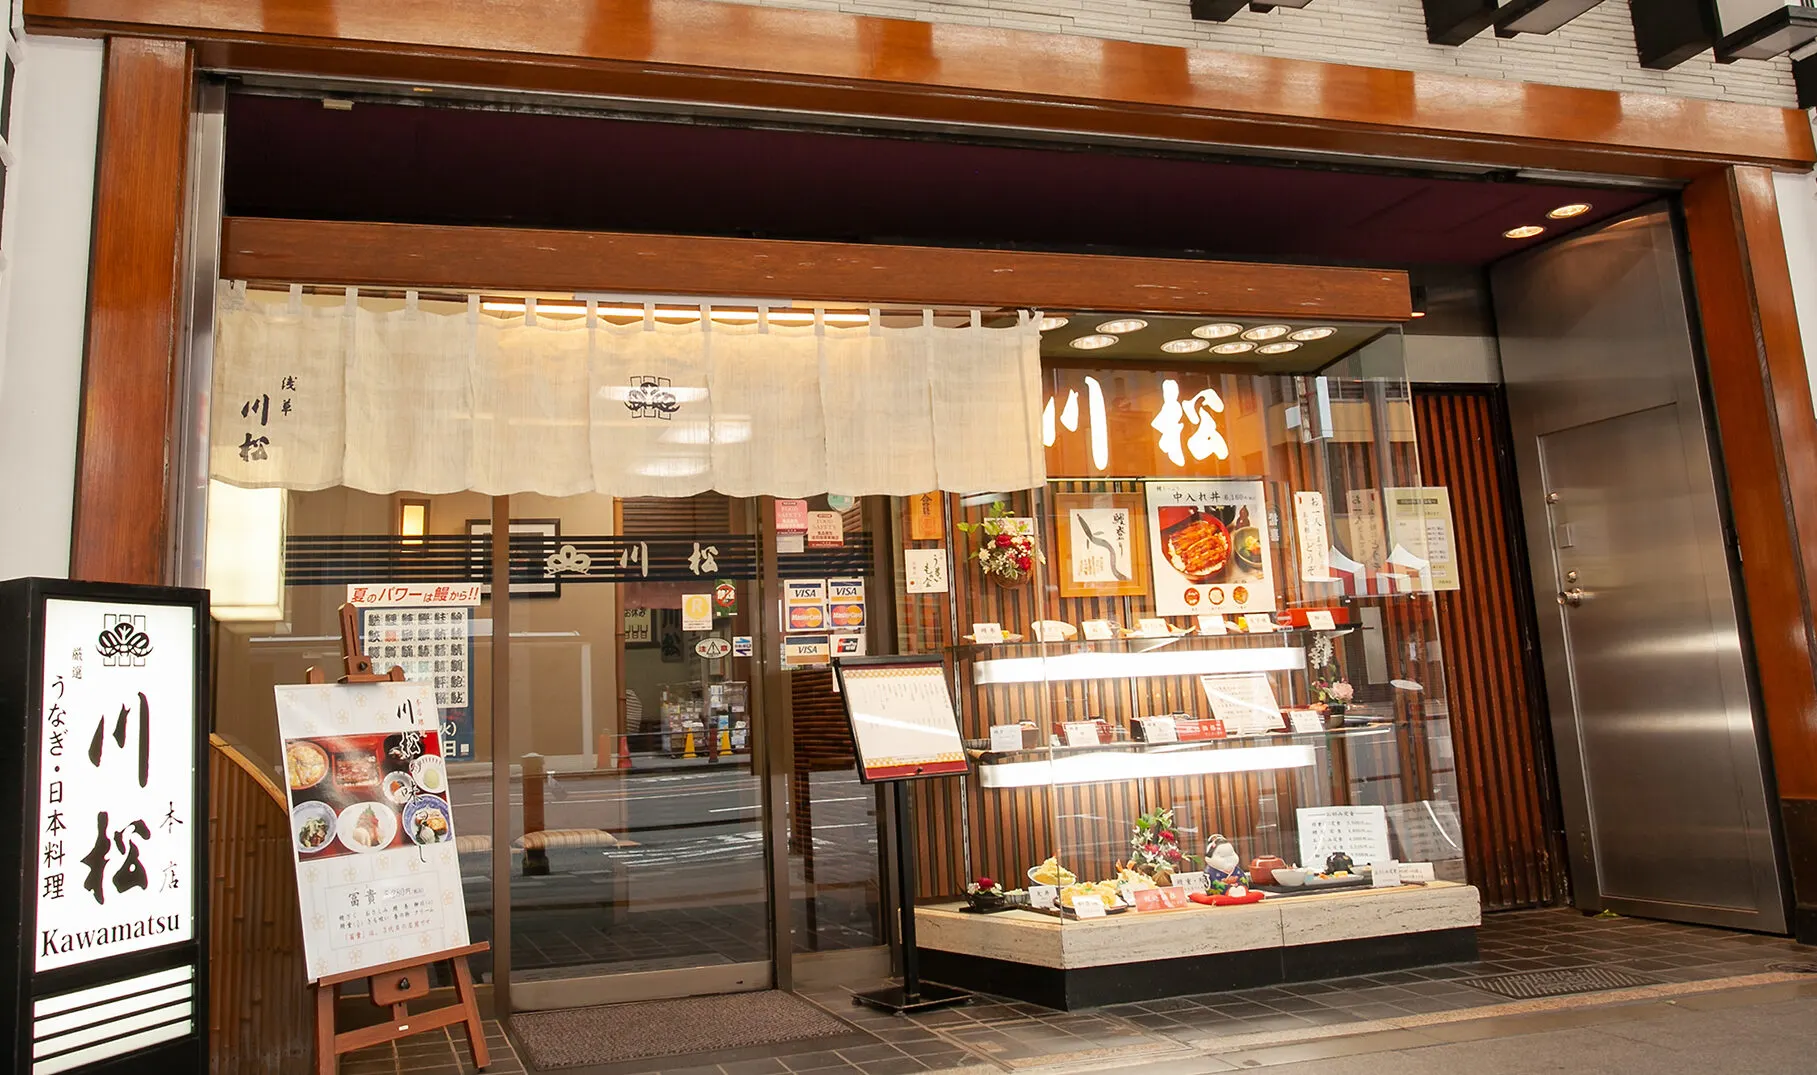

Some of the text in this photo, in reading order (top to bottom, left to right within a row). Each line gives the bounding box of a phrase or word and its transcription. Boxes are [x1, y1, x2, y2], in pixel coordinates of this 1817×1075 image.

[281, 375, 297, 416] 浅草
[238, 393, 270, 462] 川松
[1043, 375, 1229, 472] 川松
[1172, 491, 1221, 503] 中入れ丼
[619, 540, 719, 578] 川松
[352, 586, 479, 603] 夏のパワーは鰻から!!
[795, 589, 816, 597] VISA
[42, 675, 69, 901] うなぎ・日本料理
[80, 691, 152, 906] 川松
[159, 800, 184, 894] 本店
[41, 912, 181, 958] Kawamatsu
